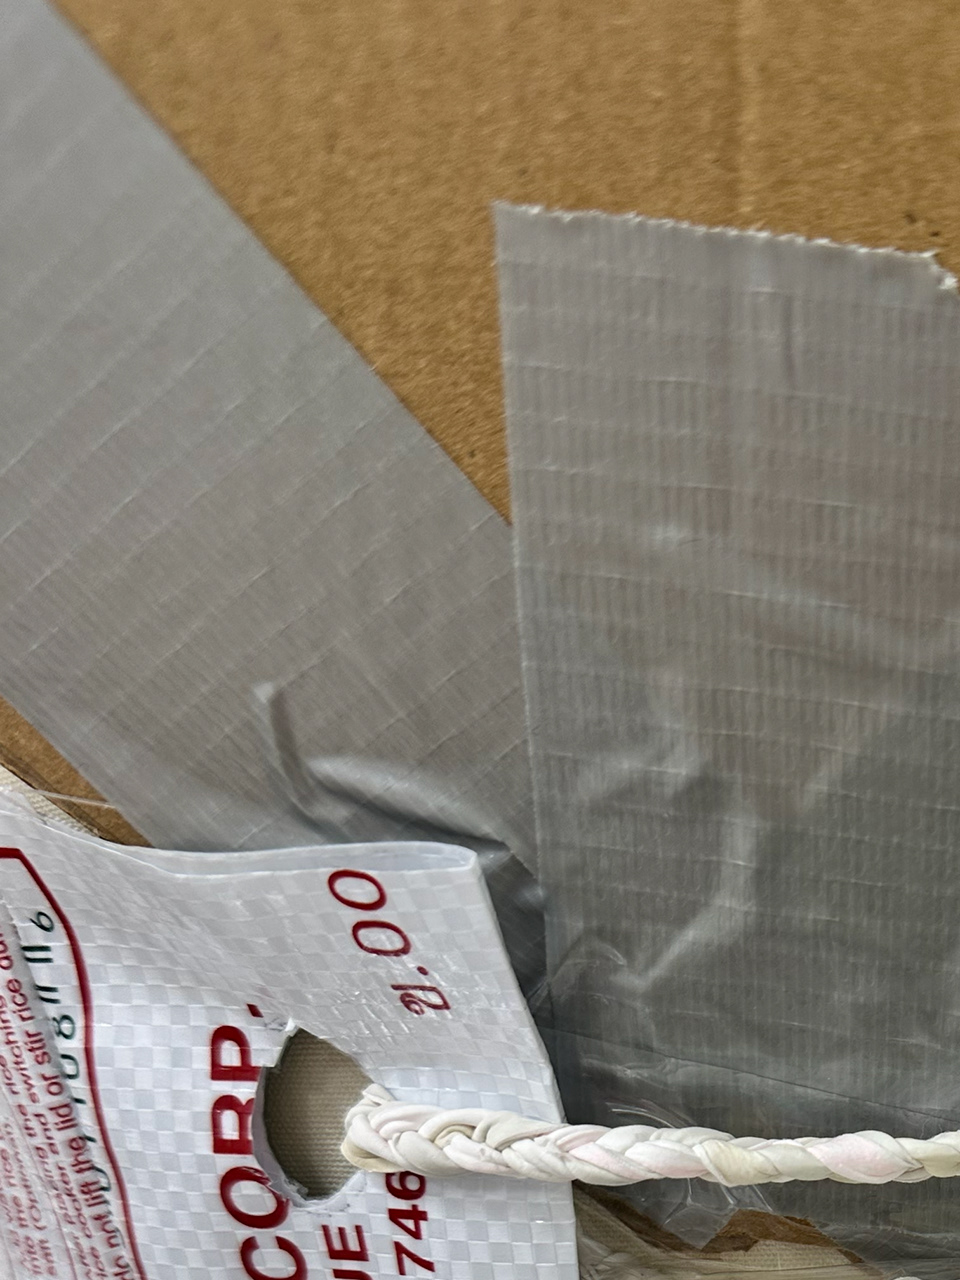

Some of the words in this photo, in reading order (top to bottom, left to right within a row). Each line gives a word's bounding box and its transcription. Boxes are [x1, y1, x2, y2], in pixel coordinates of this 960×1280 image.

[7, 978, 35, 1022] rice
[24, 1030, 51, 1065] stir
[41, 1073, 63, 1096] or
[34, 1112, 59, 1155] and
[48, 1103, 78, 1131] lid
[69, 1136, 94, 1173] the
